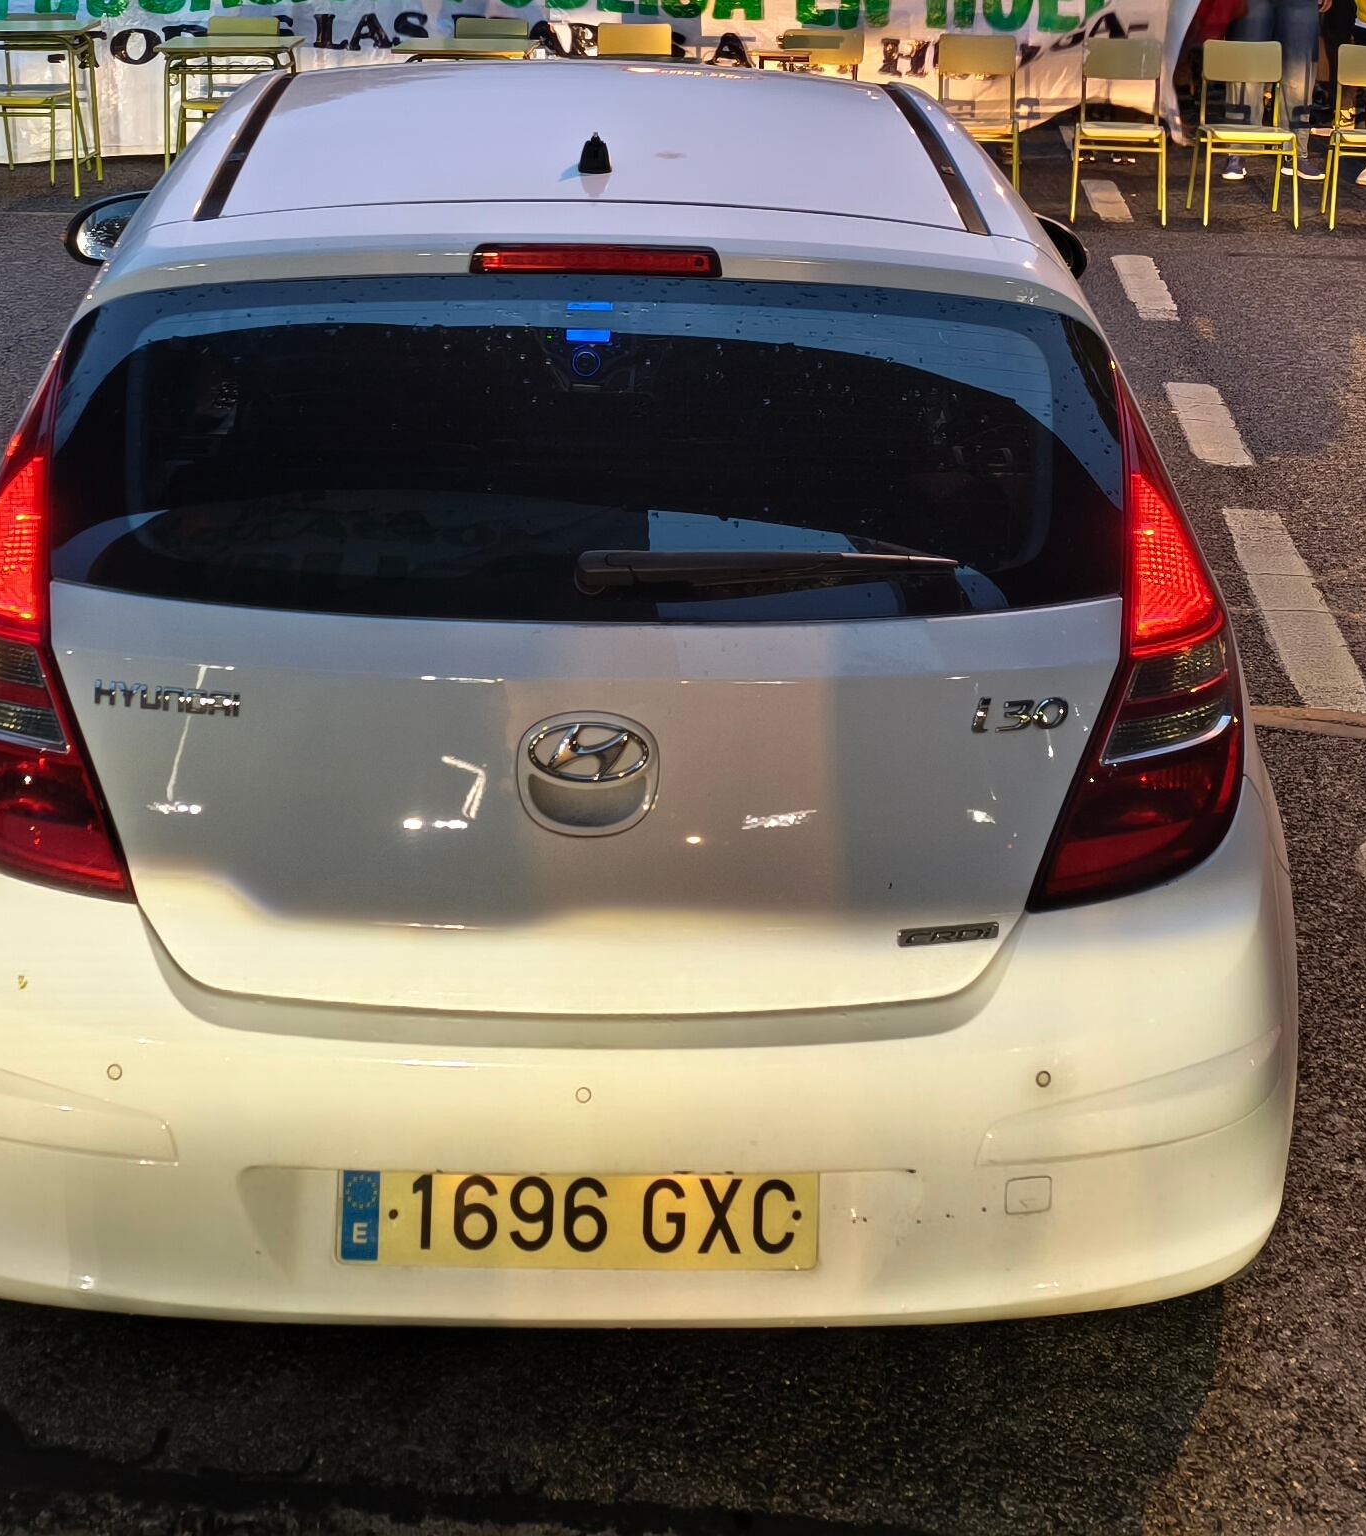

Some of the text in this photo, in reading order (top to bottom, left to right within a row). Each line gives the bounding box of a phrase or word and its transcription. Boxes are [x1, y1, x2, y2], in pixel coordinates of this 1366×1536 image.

[313, 12, 429, 52] LAS
[94, 679, 241, 717] HYUNDAI
[352, 1173, 796, 1254] E 1696 GXC
